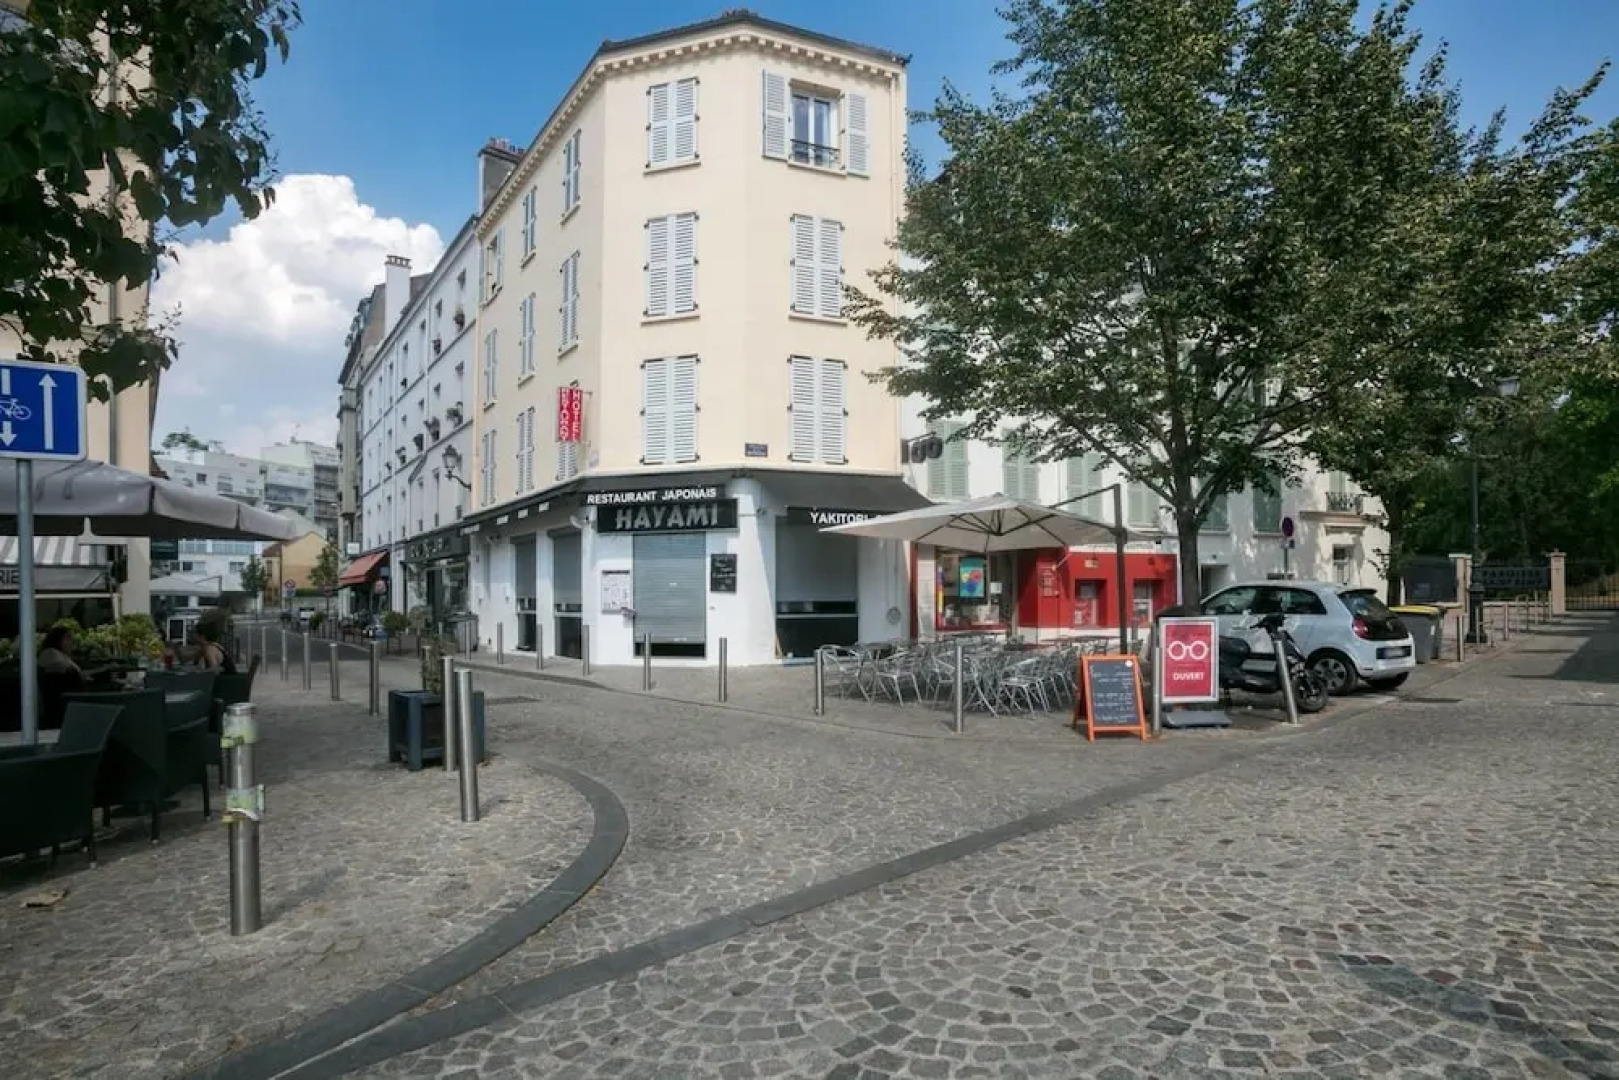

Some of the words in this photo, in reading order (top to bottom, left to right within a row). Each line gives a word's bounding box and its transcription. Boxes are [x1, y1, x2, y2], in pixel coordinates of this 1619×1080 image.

[587, 490, 657, 504] RESTAURANT
[662, 488, 716, 501] JAPONAIS
[615, 504, 718, 529] HAYAMI
[1173, 671, 1205, 681] OUVERT
